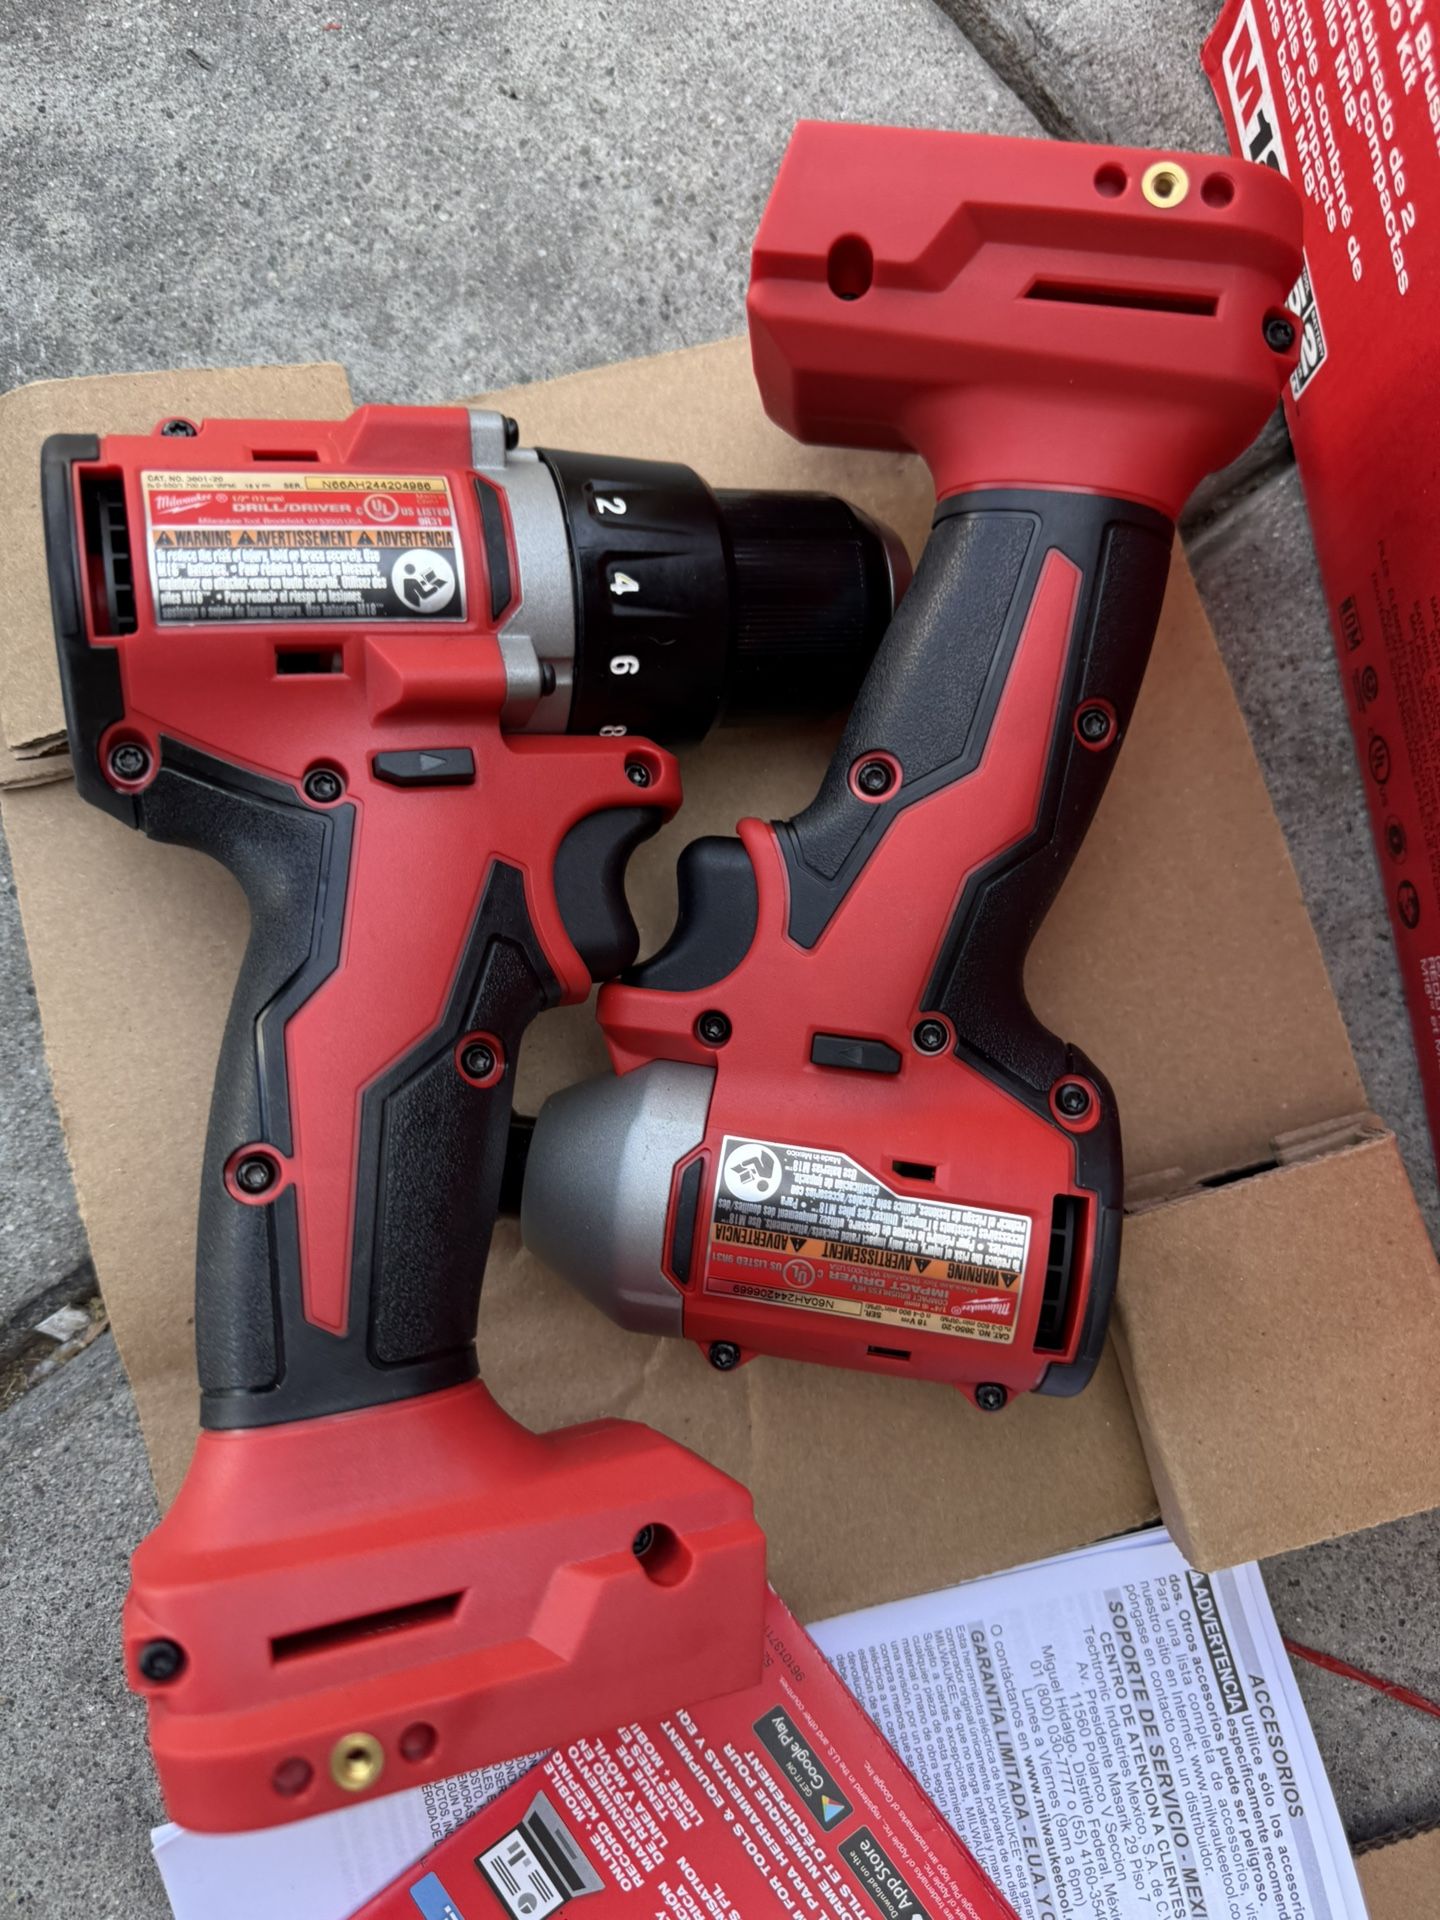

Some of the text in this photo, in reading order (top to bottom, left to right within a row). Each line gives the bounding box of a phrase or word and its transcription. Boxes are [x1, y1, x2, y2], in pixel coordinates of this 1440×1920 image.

[1277, 39, 1301, 124] balai
[1396, 31, 1418, 95] Kit
[1292, 65, 1337, 233] compacts
[1315, 83, 1353, 228] combiné
[1347, 236, 1362, 281] de
[1359, 90, 1408, 295] compactas
[1389, 148, 1415, 234] de 2
[155, 489, 212, 510] Milwaukee
[232, 503, 351, 513] DRILL/DRIVER
[400, 507, 414, 516] US
[416, 507, 450, 517] LISTED
[595, 497, 627, 515] 2
[174, 530, 454, 547] WARNING AVERTISSEMENT ADVERTENCIA
[609, 572, 640, 596] 4
[610, 655, 640, 675] 6
[785, 1149, 842, 1165] Made in Mexico
[715, 1224, 789, 1251] ADVERTENCIA
[821, 1242, 913, 1272] AVERTISSEMENT
[829, 1270, 886, 1288] DRIVER
[890, 1281, 949, 1299] IMPACT
[947, 1263, 999, 1287] WARNING
[959, 1298, 1010, 1316] Milwaukee
[863, 1309, 882, 1319] SER.
[989, 1623, 1003, 1637] O
[1108, 1601, 1150, 1702] SOPORTE
[1193, 1587, 1243, 1713] ADVERTENCIA
[970, 1630, 1006, 1726] GARANTÍA
[993, 1640, 1024, 1729] contáctanos
[694, 1737, 705, 1750] Y
[771, 1716, 824, 1790] Google Play
[1017, 1731, 1030, 1752] en
[1138, 1708, 1160, 1738] DE
[1168, 1573, 1268, 1907] dos. Otros accesorios puede ser peligroso.
[1247, 1674, 1304, 1818] ACCESORIOS
[543, 1761, 586, 1822] MOBILE
[577, 1738, 665, 1865] DE REGISTRO EN
[594, 1738, 669, 1848] LÍNEA Y MÓVIL
[615, 1744, 669, 1821] TENUE DE
[630, 1743, 692, 1831] REGISTRES
[667, 1778, 704, 1827] LIGNE
[673, 1737, 725, 1809] EQUIPMENT
[785, 1761, 813, 1797] GET IT ON
[995, 1730, 1030, 1821] LIMITADA
[1021, 1687, 1088, 1907] Lunes a Viernes (9am a 6pm)
[1075, 1661, 1152, 1902] Av. Presidente Masarik 29 Piso 7
[1099, 1631, 1187, 1920] CENTRO DE ATENCION A CLIENTES
[1148, 1744, 1190, 1848] SERVICIO
[552, 1751, 645, 1888] RECORD KEEPING
[568, 1745, 655, 1873] MANTENIMIENTO
[704, 1748, 789, 1867] HERRAMIENTAS
[723, 1743, 854, 1920] ORME NUMÉRIQUE POUR
[744, 1751, 842, 1884] ET D’ÉQUIPEMENT
[1226, 1717, 1292, 1920] específicamente recomend
[1241, 1713, 1306, 1920] Utilice sólo los accesorio
[589, 1832, 632, 1892] ONLINE
[732, 1822, 771, 1877] TOOLS
[859, 1839, 913, 1910] App Store
[1021, 1836, 1046, 1890] E.U.A.
[769, 1875, 796, 1910] FOR
[787, 1865, 819, 1911] PARA
[849, 1850, 899, 1919] Download on the
[1036, 1893, 1053, 1907] Y
[1040, 1911, 1056, 1920] C
[1181, 1867, 1208, 1918] MEXI
